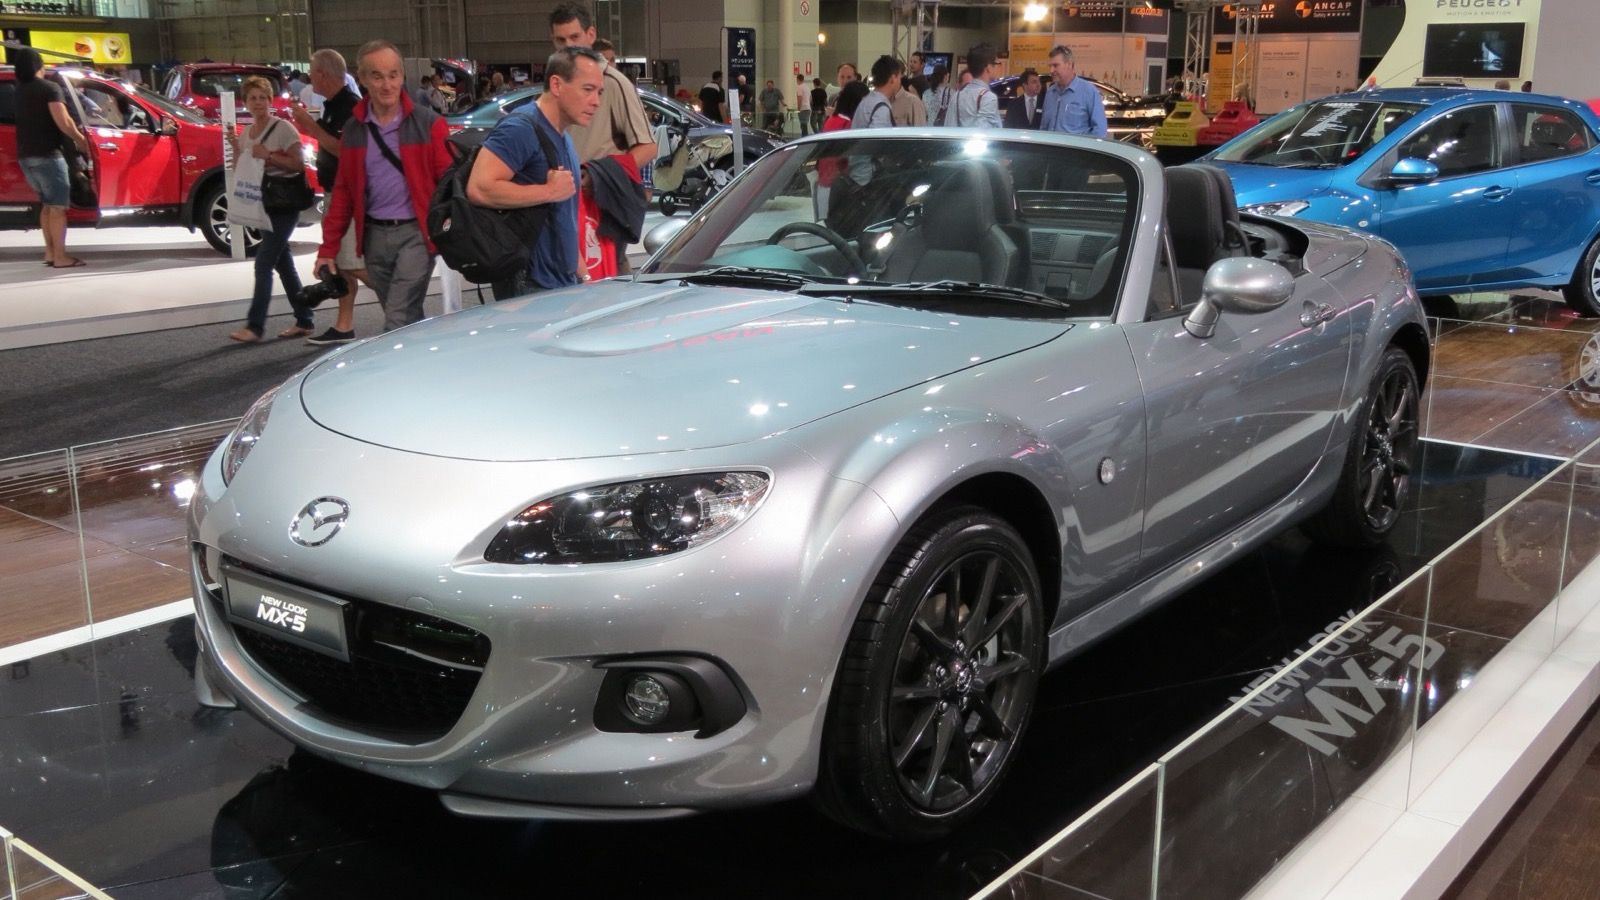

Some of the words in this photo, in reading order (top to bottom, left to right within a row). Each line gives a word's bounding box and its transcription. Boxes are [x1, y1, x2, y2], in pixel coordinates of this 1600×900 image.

[1313, 2, 1352, 10] ANCAP
[1436, 0, 1521, 8] PEUGEOT
[257, 602, 307, 632] MX-5
[260, 594, 282, 608] NEW
[282, 601, 308, 616] LOOK
[1227, 656, 1311, 717] NEW
[1293, 608, 1385, 668] LOOK
[1268, 625, 1446, 757] MX-5
